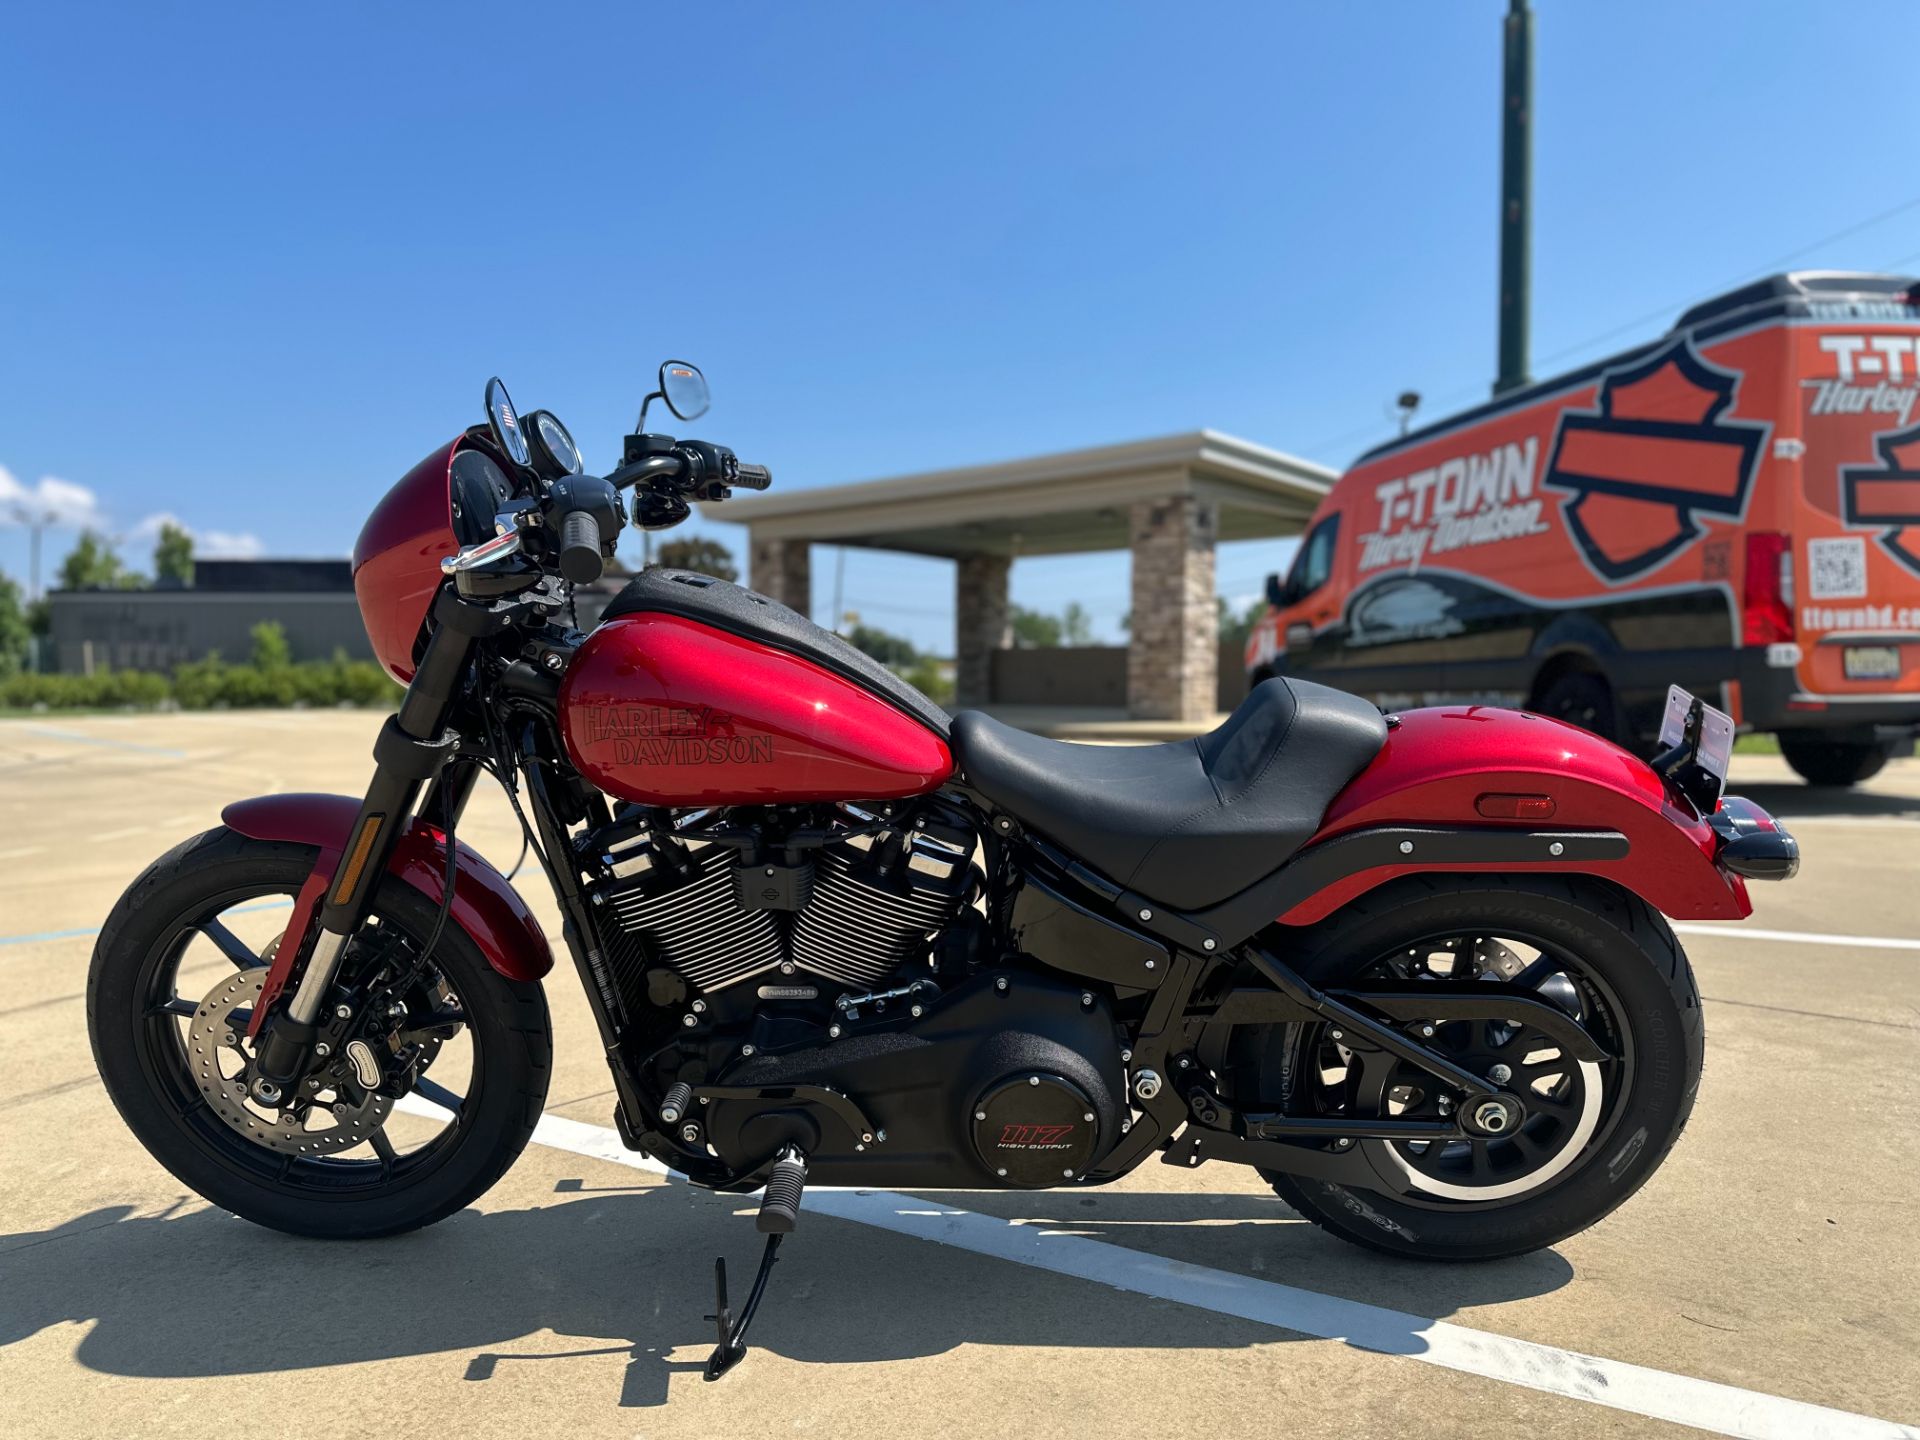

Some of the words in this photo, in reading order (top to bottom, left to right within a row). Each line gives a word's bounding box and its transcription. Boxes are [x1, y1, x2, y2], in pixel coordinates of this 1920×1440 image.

[1820, 336, 1920, 383] T-T
[1376, 436, 1539, 532] T-TOWN
[613, 735, 776, 766] DAVIDSON
[1000, 1125, 1074, 1143] 117
